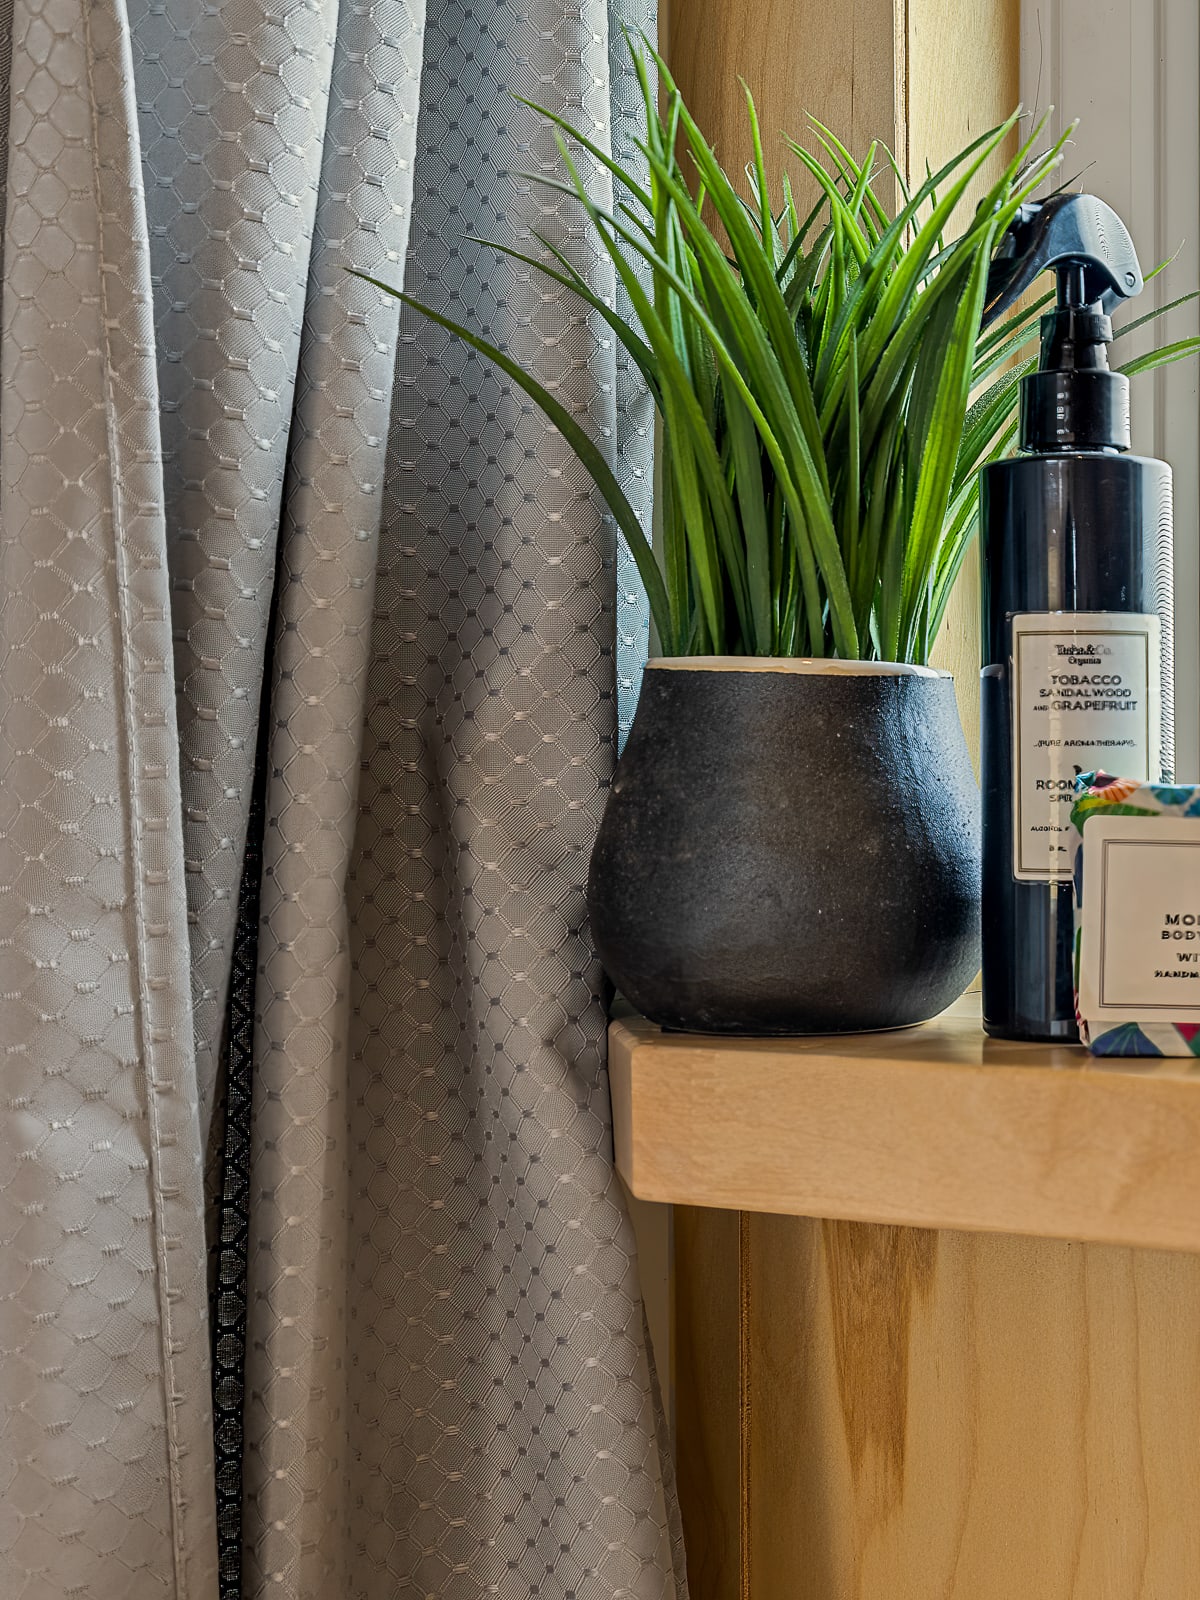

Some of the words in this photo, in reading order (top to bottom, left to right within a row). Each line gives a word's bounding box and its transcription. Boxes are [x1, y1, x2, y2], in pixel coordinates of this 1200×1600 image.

[1051, 674, 1122, 685] TOBACCO
[1039, 689, 1132, 698] SANDALWOOD
[1050, 701, 1138, 711] GRAPEFRUIT
